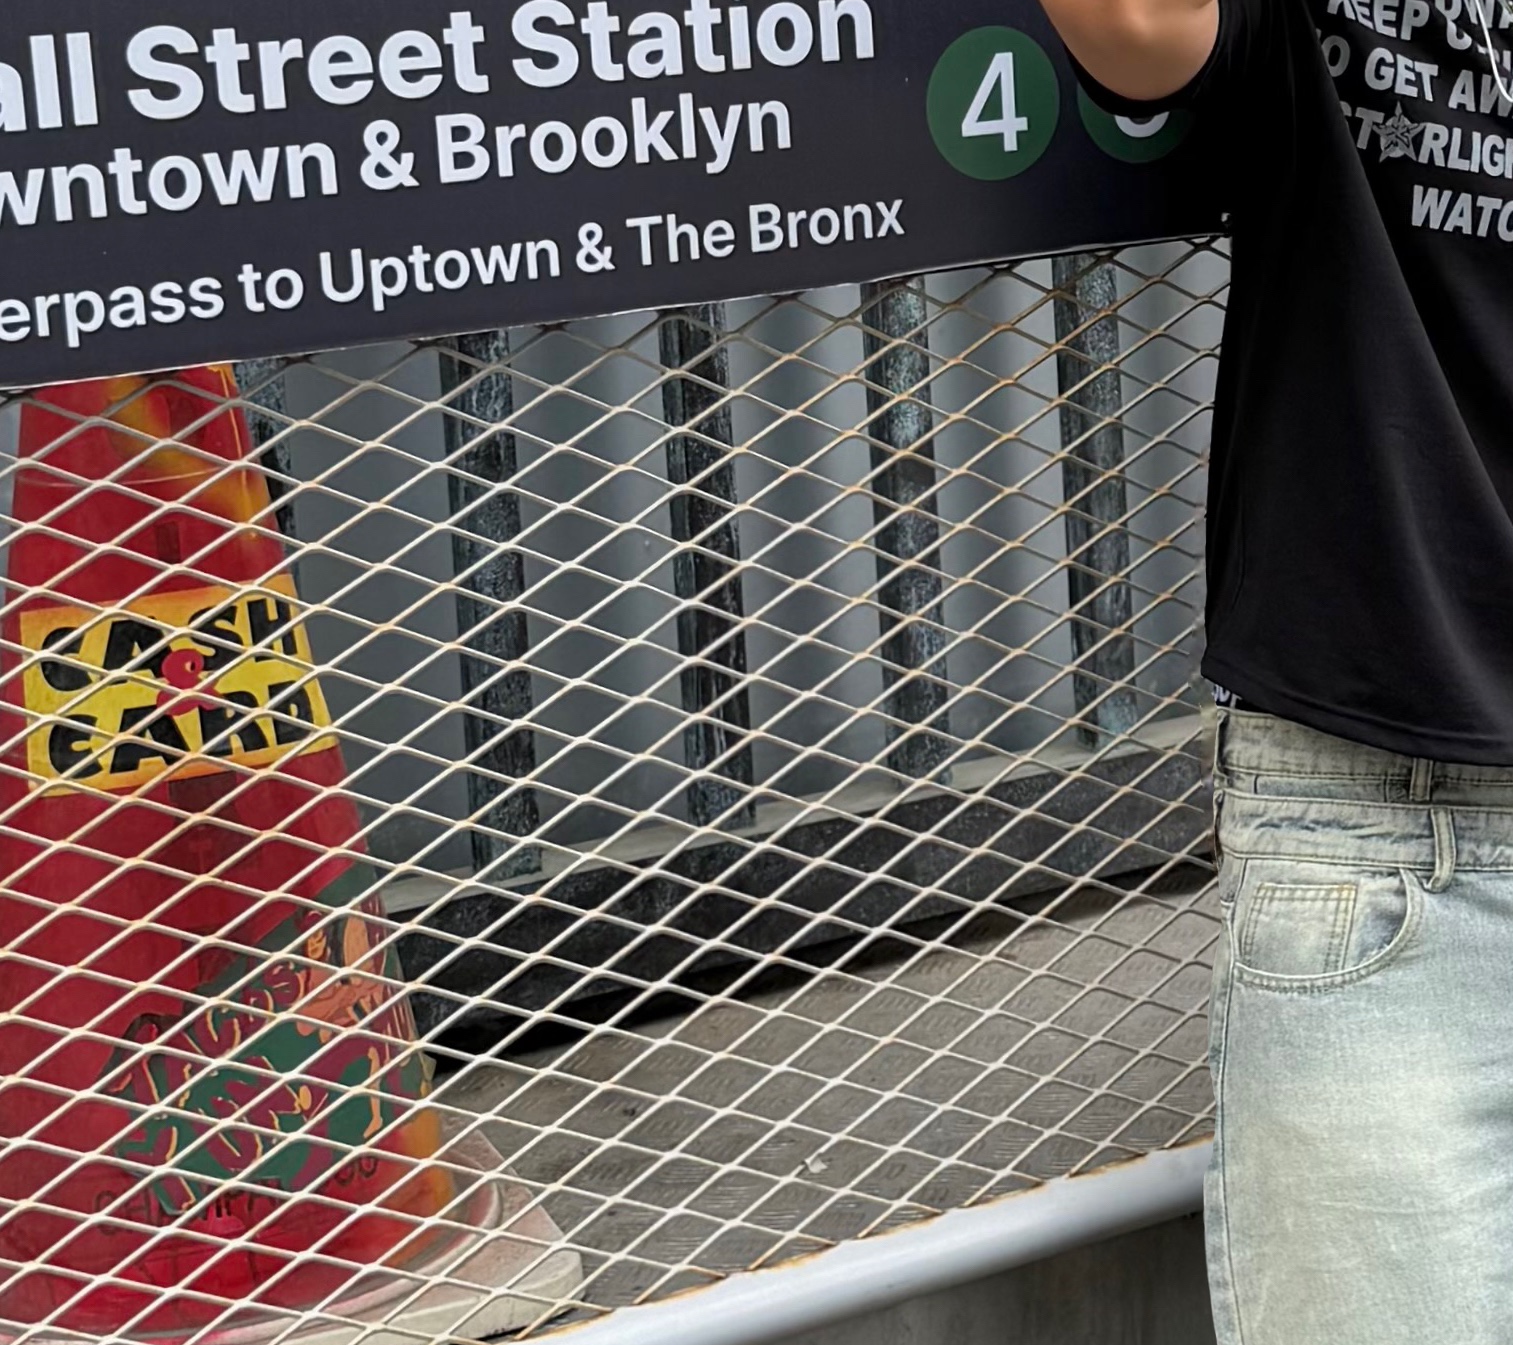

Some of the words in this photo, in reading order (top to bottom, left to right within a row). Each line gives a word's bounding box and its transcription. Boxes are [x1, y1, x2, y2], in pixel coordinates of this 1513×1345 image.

[126, 11, 489, 120] Street
[960, 51, 1029, 153] 4
[1315, 28, 1350, 77] O
[1364, 47, 1438, 102] GET
[359, 119, 420, 190] &
[434, 92, 792, 184] Brooklyn
[0, 275, 224, 348] erpass
[238, 263, 304, 312] to
[319, 238, 560, 311] Uptown
[575, 221, 616, 274] &
[626, 213, 735, 266] The
[749, 199, 905, 253] Bronx
[40, 598, 298, 691] CASH
[49, 680, 314, 779] CARD
